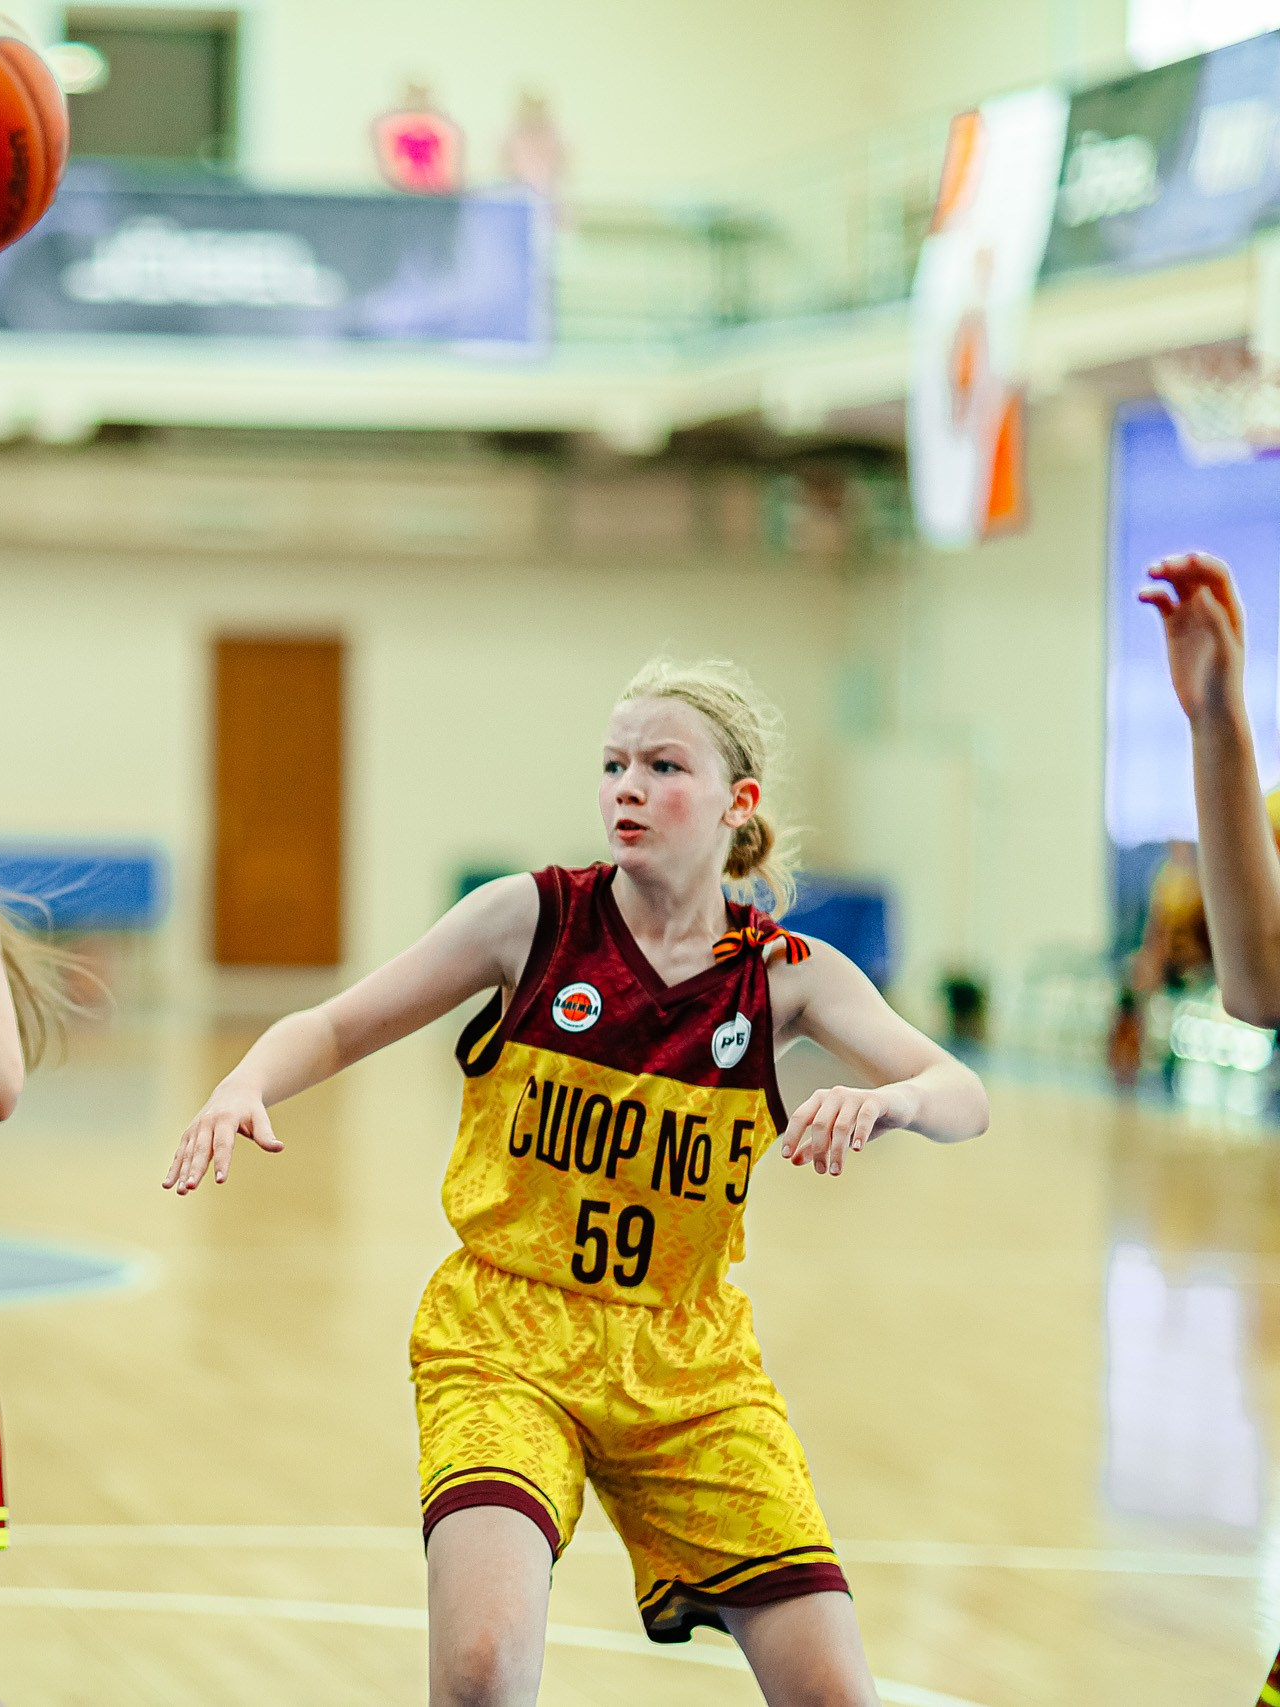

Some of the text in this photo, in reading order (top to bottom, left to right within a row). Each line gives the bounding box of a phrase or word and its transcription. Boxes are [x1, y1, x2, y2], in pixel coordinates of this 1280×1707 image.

[509, 1076, 755, 1205] СШОР № 5
[571, 1199, 656, 1288] 59
